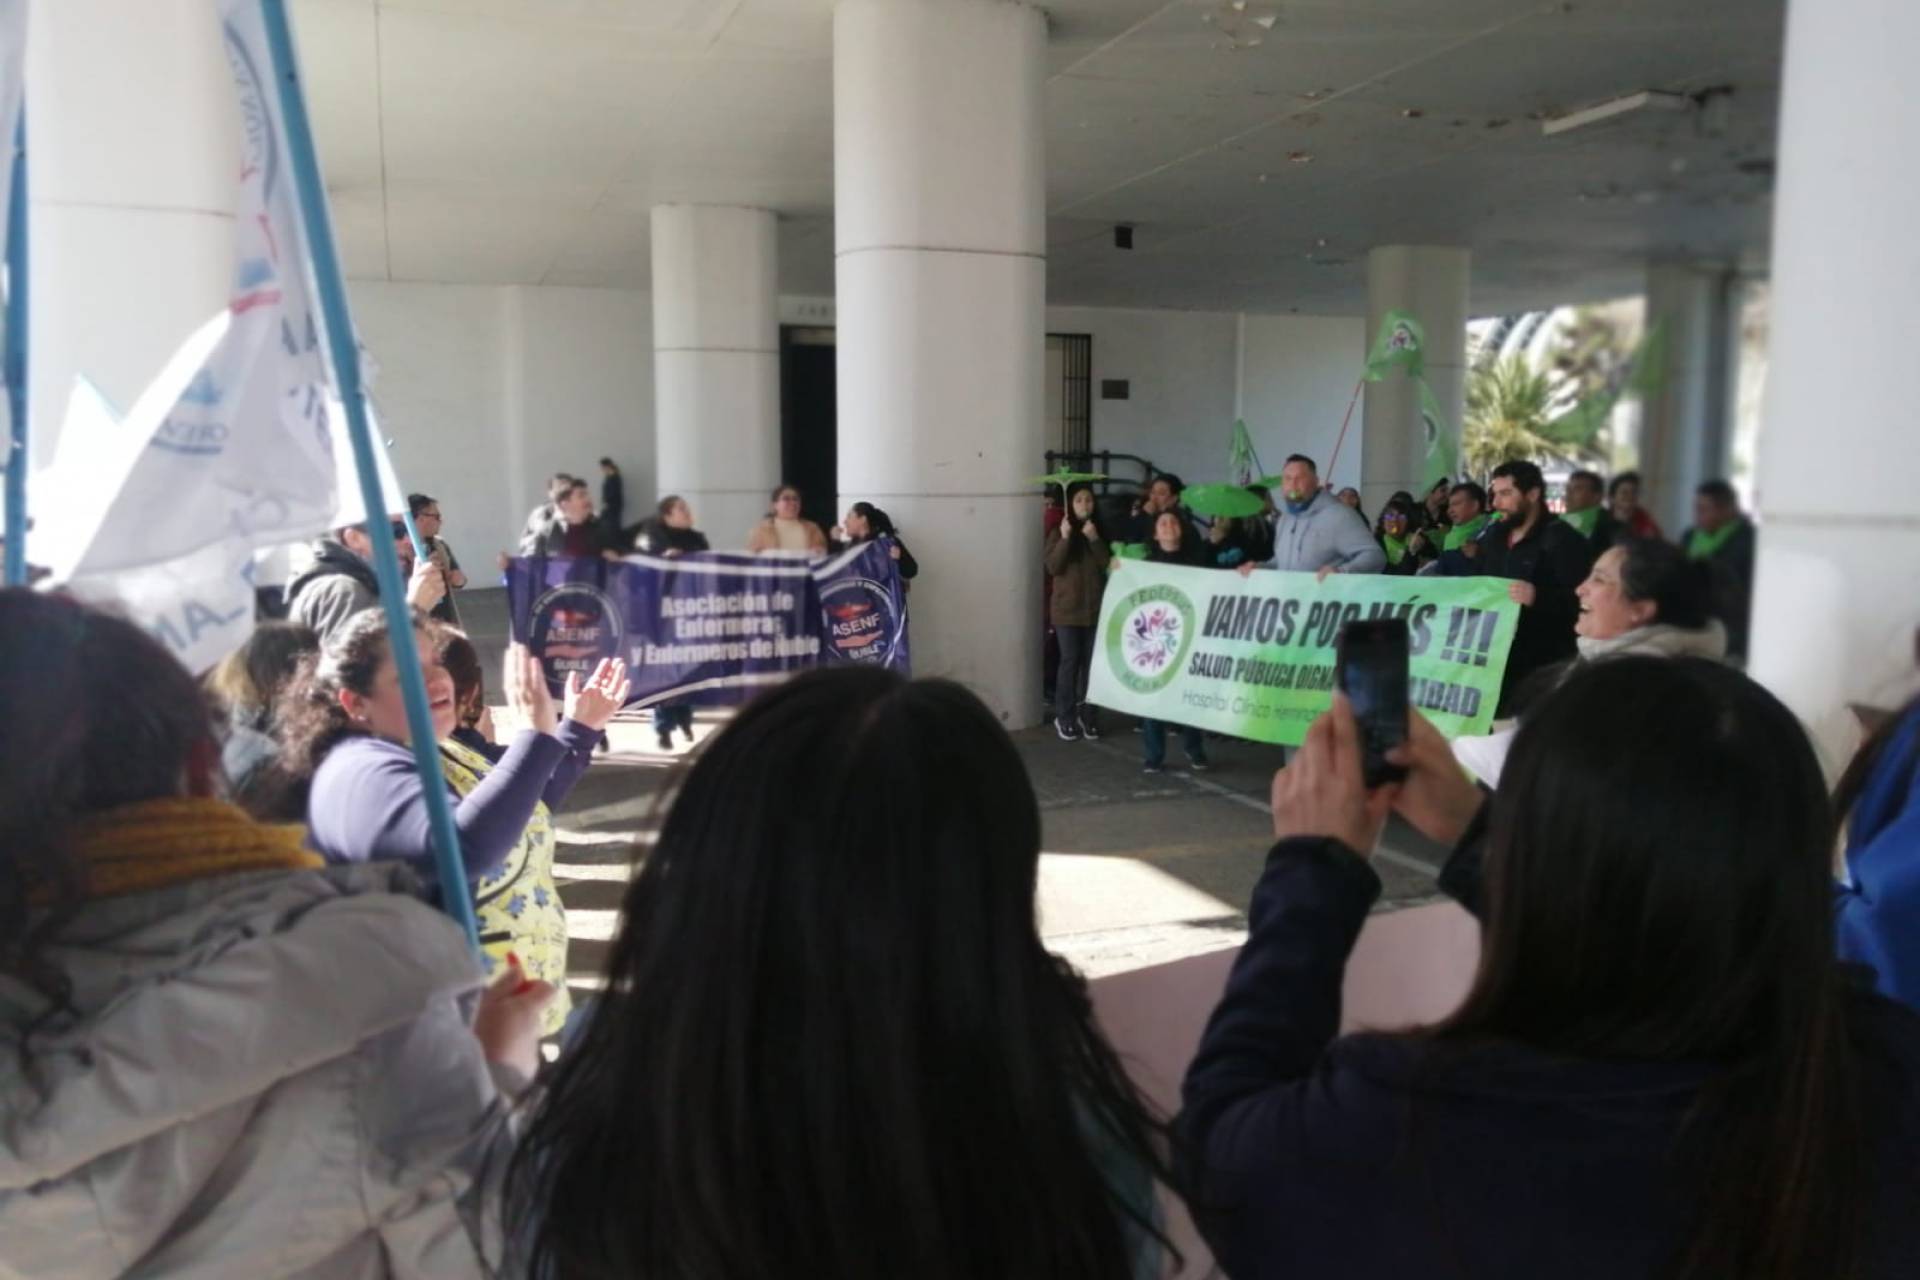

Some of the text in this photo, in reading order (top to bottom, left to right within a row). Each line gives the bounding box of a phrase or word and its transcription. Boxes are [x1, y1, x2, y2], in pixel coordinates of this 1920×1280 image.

[661, 592, 768, 618] Asociación
[771, 591, 793, 611] de
[545, 627, 600, 642] ASENF
[675, 615, 782, 639] Enfermeras
[832, 612, 880, 636] ASENF
[1201, 594, 1299, 647] VAMOS
[1440, 606, 1499, 667] !!!
[646, 640, 748, 665] Enfermeros
[750, 637, 773, 659] de
[1189, 651, 1234, 680] SALUD
[1234, 655, 1297, 689] PÚBLICA
[1182, 690, 1229, 712] Hospital
